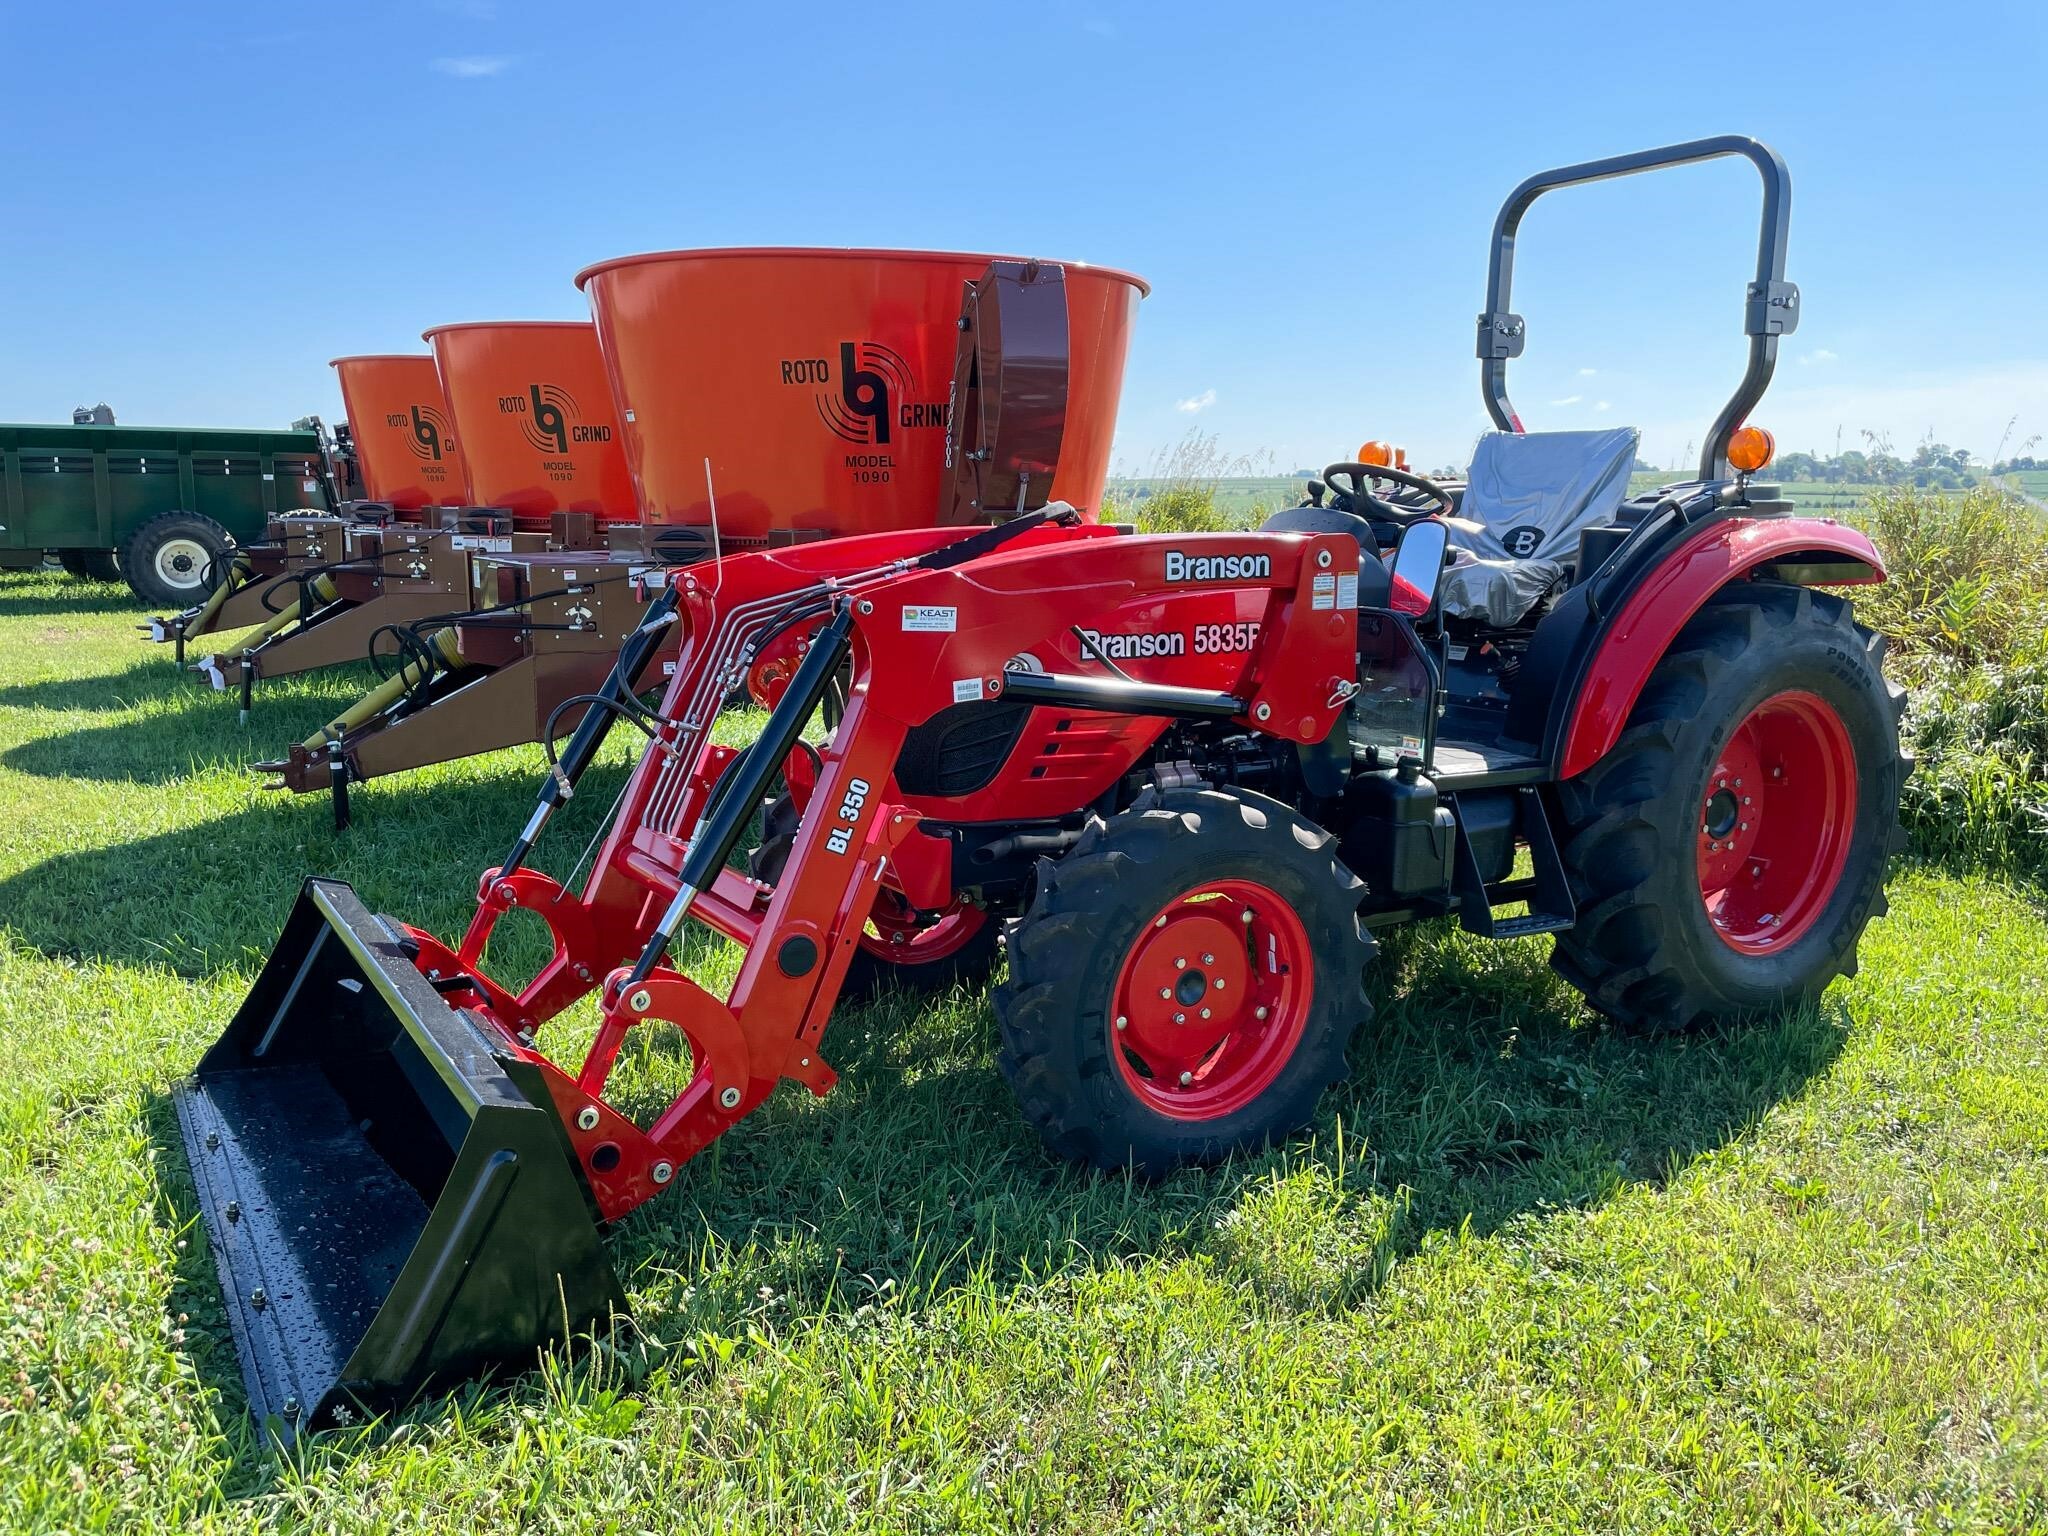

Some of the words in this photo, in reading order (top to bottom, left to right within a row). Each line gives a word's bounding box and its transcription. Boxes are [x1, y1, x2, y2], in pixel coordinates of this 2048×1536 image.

[781, 359, 829, 384] ROTO
[498, 396, 526, 413] ROTO
[386, 414, 408, 428] ROTO
[572, 426, 611, 442] GRIND
[543, 461, 576, 471] MODEL
[845, 455, 896, 467] MODEL
[421, 466, 447, 474] MODEL
[549, 473, 573, 481] 1090
[853, 471, 890, 483] 1090
[426, 474, 445, 482] 1090
[1514, 531, 1536, 555] B
[1166, 551, 1270, 581] Branson
[920, 609, 955, 618] KEAST
[1081, 629, 1185, 660] Branson
[839, 777, 870, 822] 350
[825, 826, 855, 856] BL
